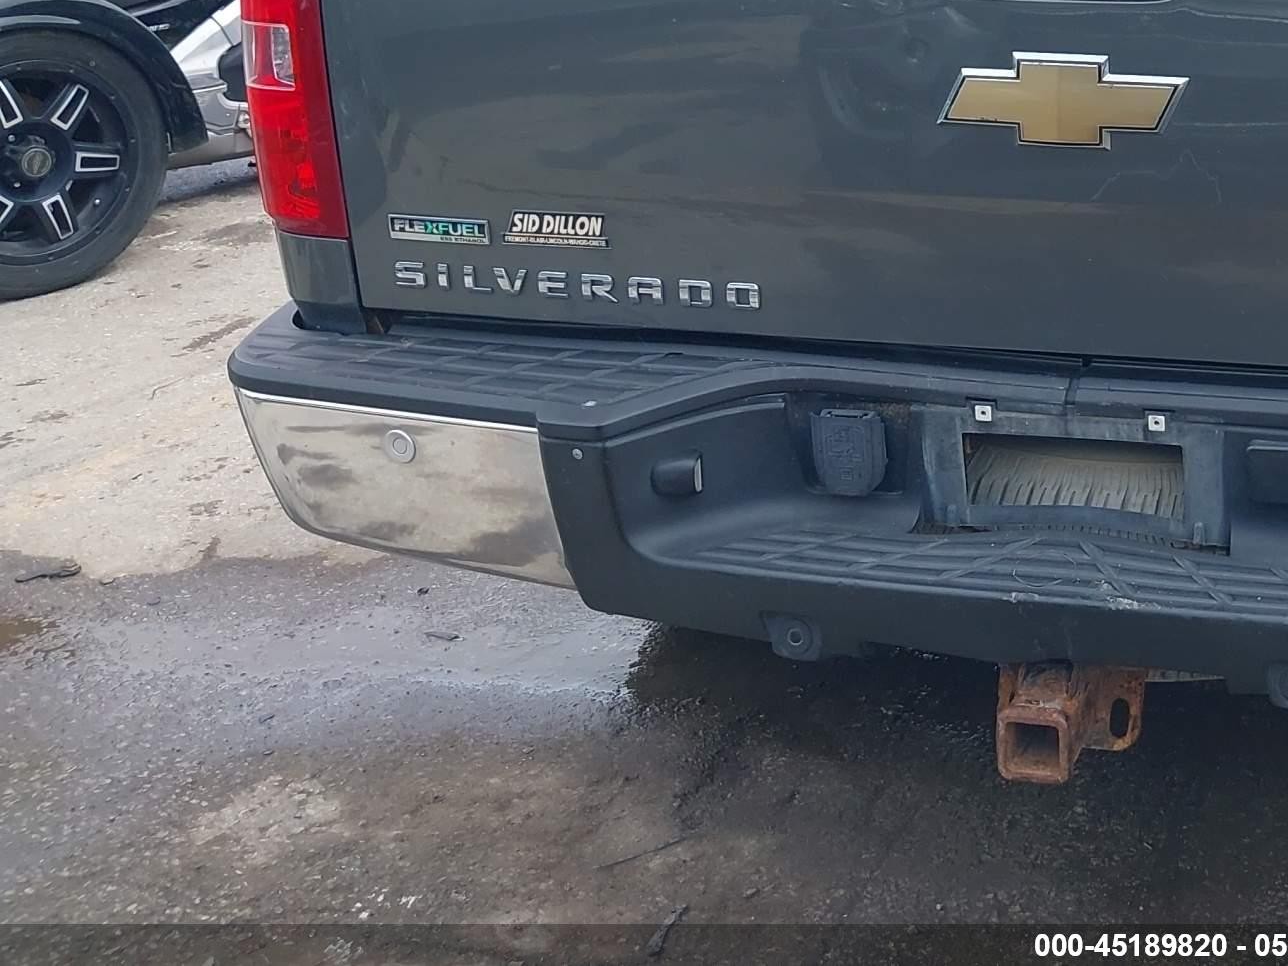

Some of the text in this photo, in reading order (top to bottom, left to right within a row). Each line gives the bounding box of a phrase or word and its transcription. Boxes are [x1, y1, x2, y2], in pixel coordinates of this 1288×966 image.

[393, 218, 485, 236] FLEXFUEL
[512, 213, 602, 236] SID DILLON
[394, 261, 761, 310] SILVERADO
